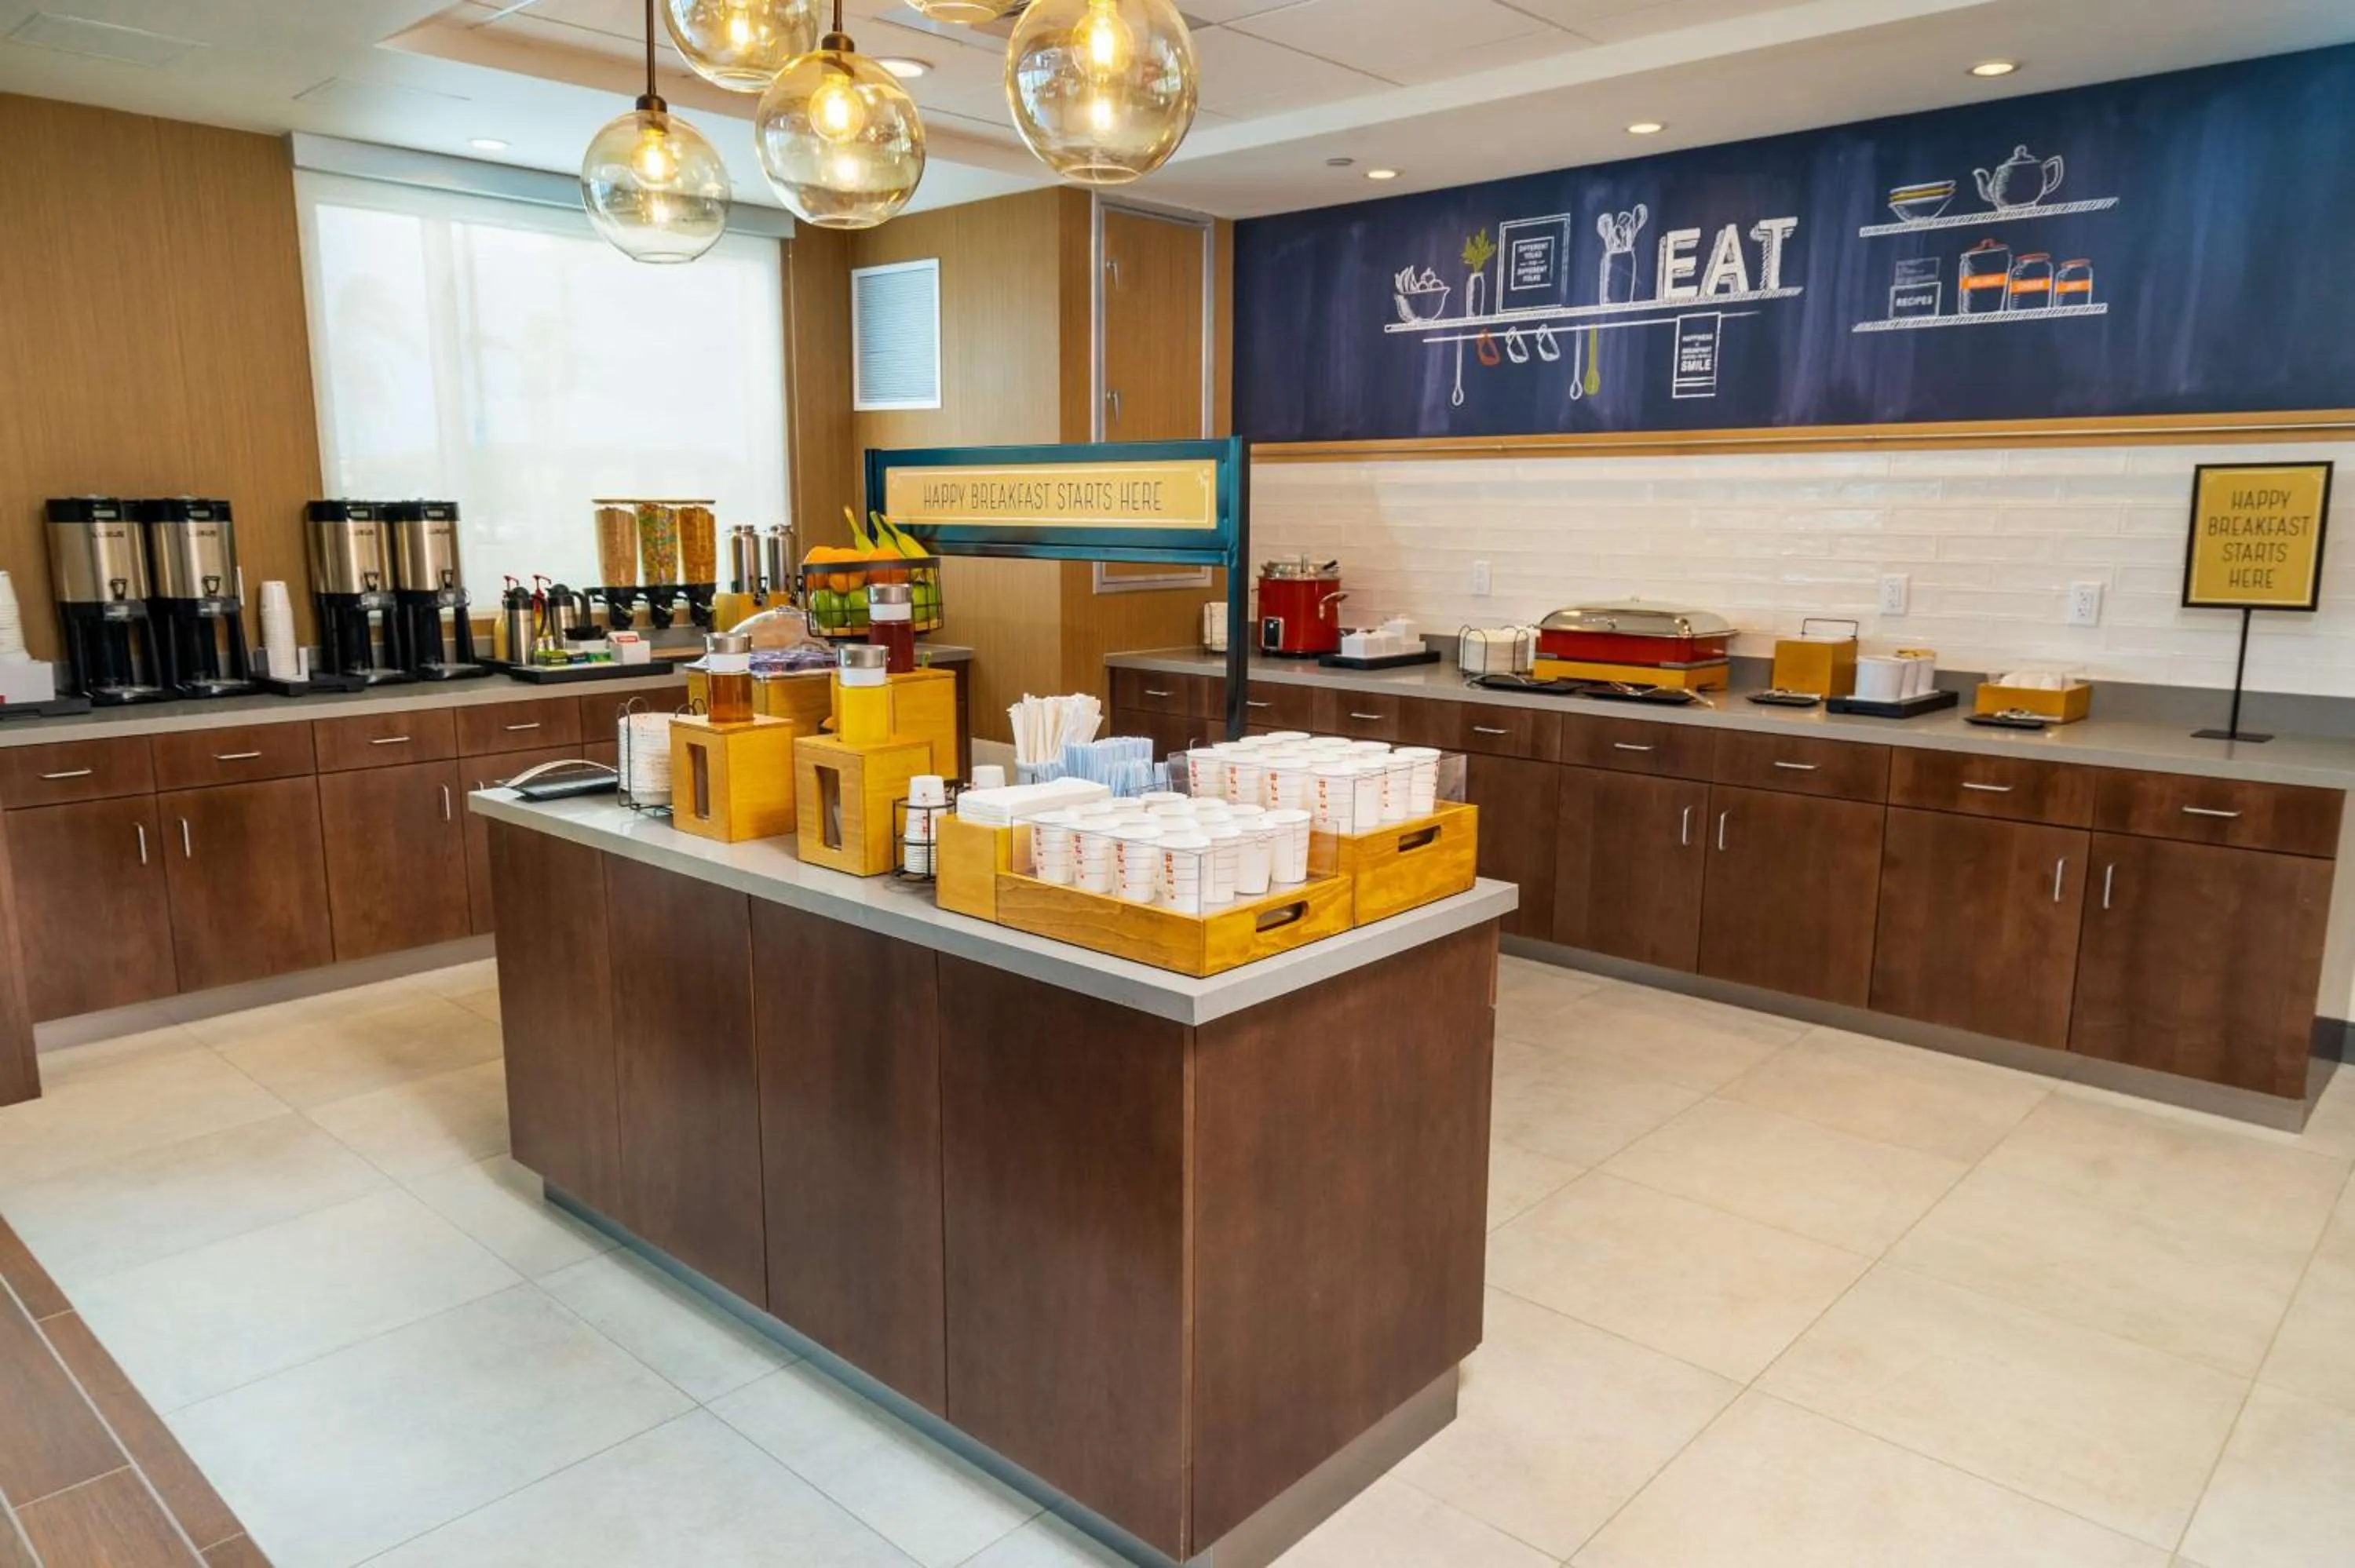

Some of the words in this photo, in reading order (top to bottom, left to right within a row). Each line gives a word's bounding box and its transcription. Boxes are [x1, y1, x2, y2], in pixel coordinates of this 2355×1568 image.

[1656, 216, 1798, 300] EAT
[1896, 295, 1933, 307] RECIPES
[1681, 359, 1712, 371] SMILE
[923, 483, 966, 509] HAPPY
[970, 483, 1050, 510] BREAKFAST
[1057, 483, 1112, 511] STARTS
[1120, 481, 1163, 511] HERE
[2231, 489, 2292, 510] HAPPY
[2207, 516, 2311, 537] BREAKFAST
[2222, 542, 2288, 563] STARTS
[2228, 568, 2276, 589] HERE
